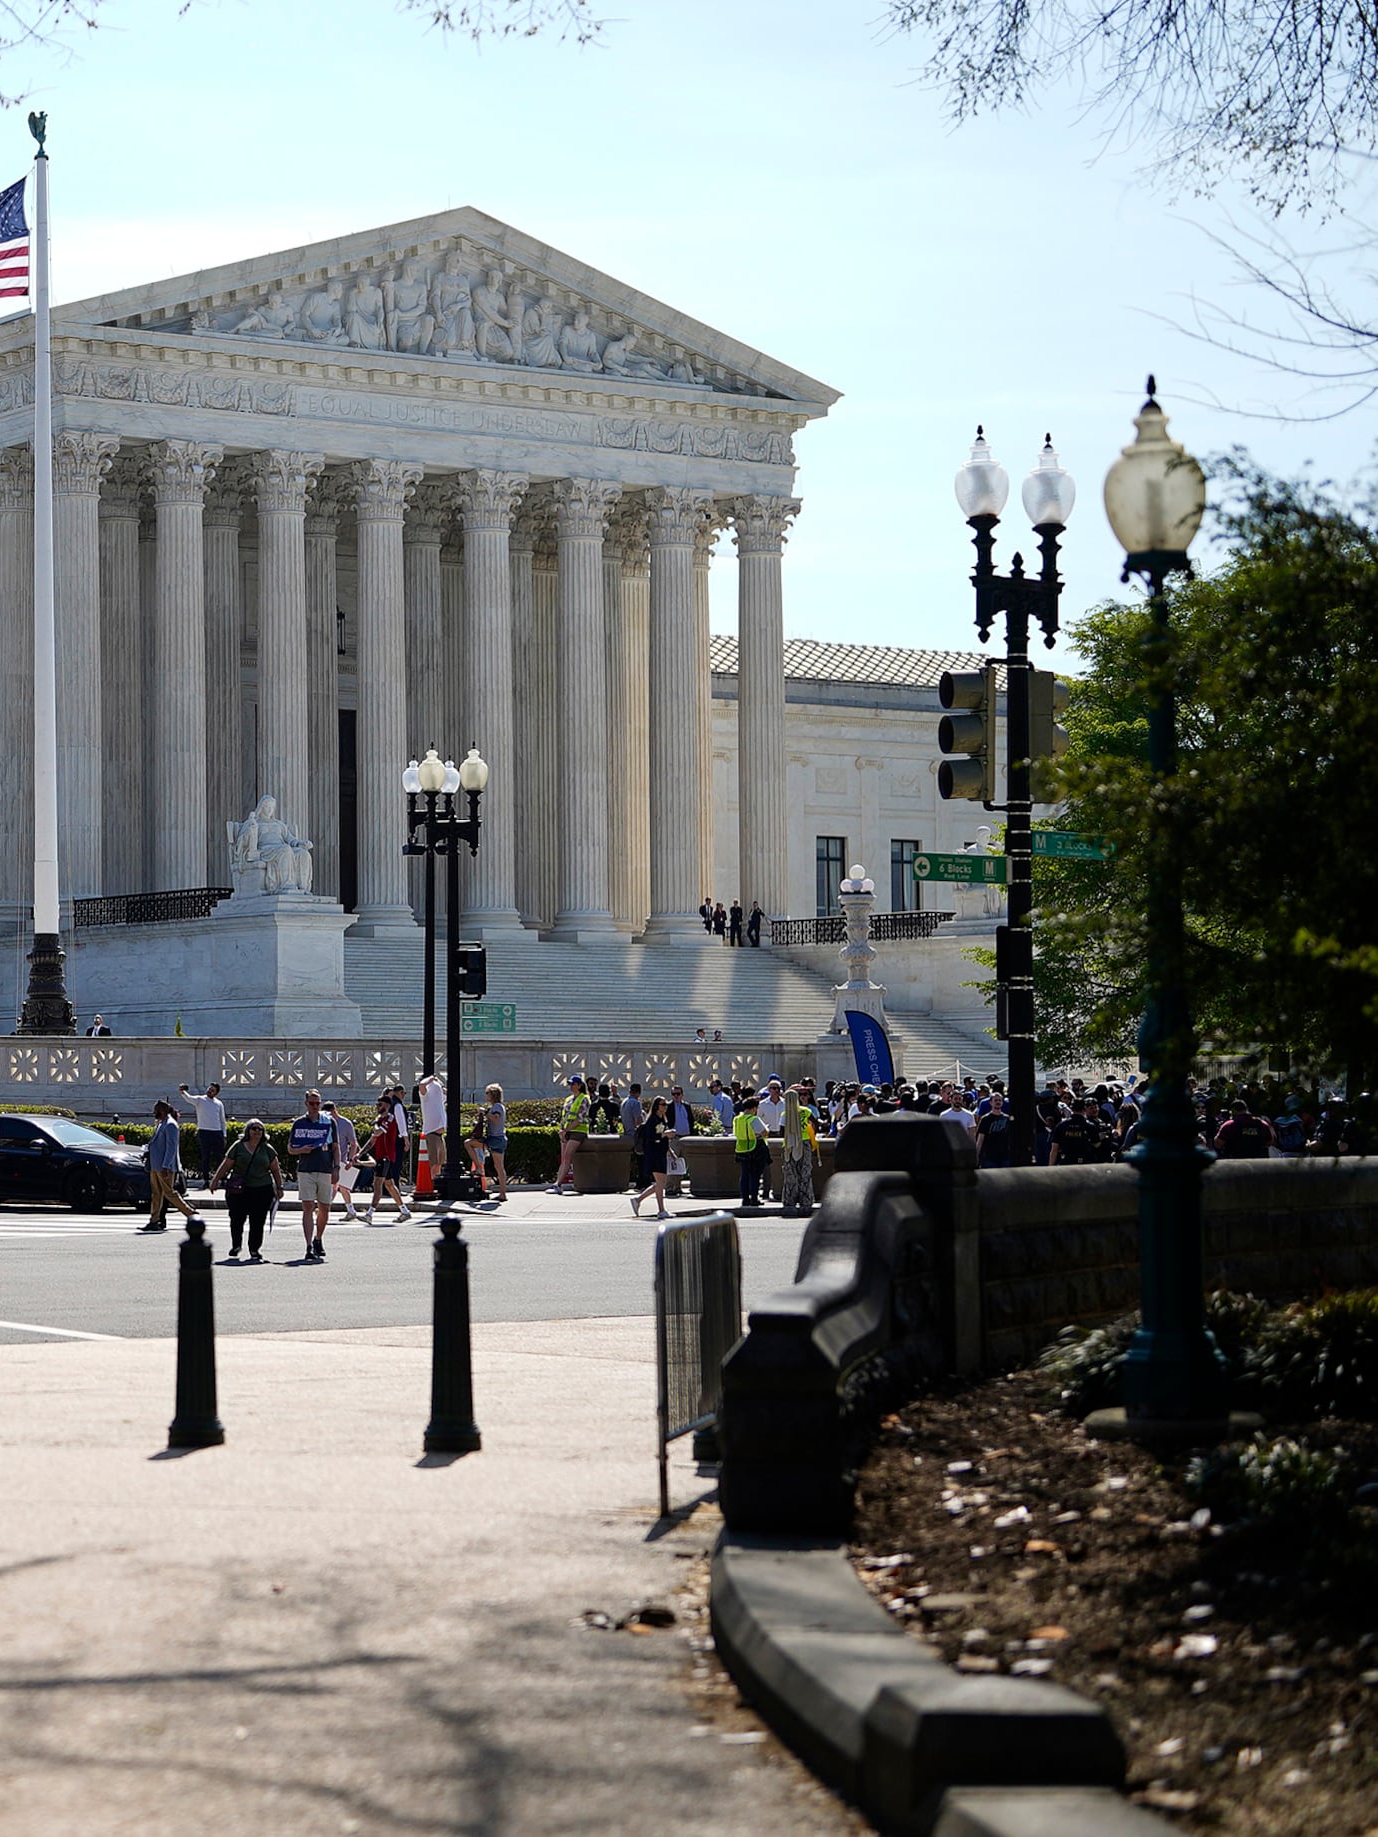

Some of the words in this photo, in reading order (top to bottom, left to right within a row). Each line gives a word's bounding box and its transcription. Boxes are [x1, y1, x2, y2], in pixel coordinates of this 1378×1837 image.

[308, 394, 376, 418] EQUAL
[384, 401, 462, 427] JUSTICE
[472, 409, 537, 434] UNDER
[541, 416, 582, 438] LAW
[1035, 834, 1046, 849] M
[939, 863, 945, 873] 6
[947, 863, 972, 874] Blocks
[863, 1029, 878, 1061] PRESS
[870, 1063, 882, 1086] CHE
